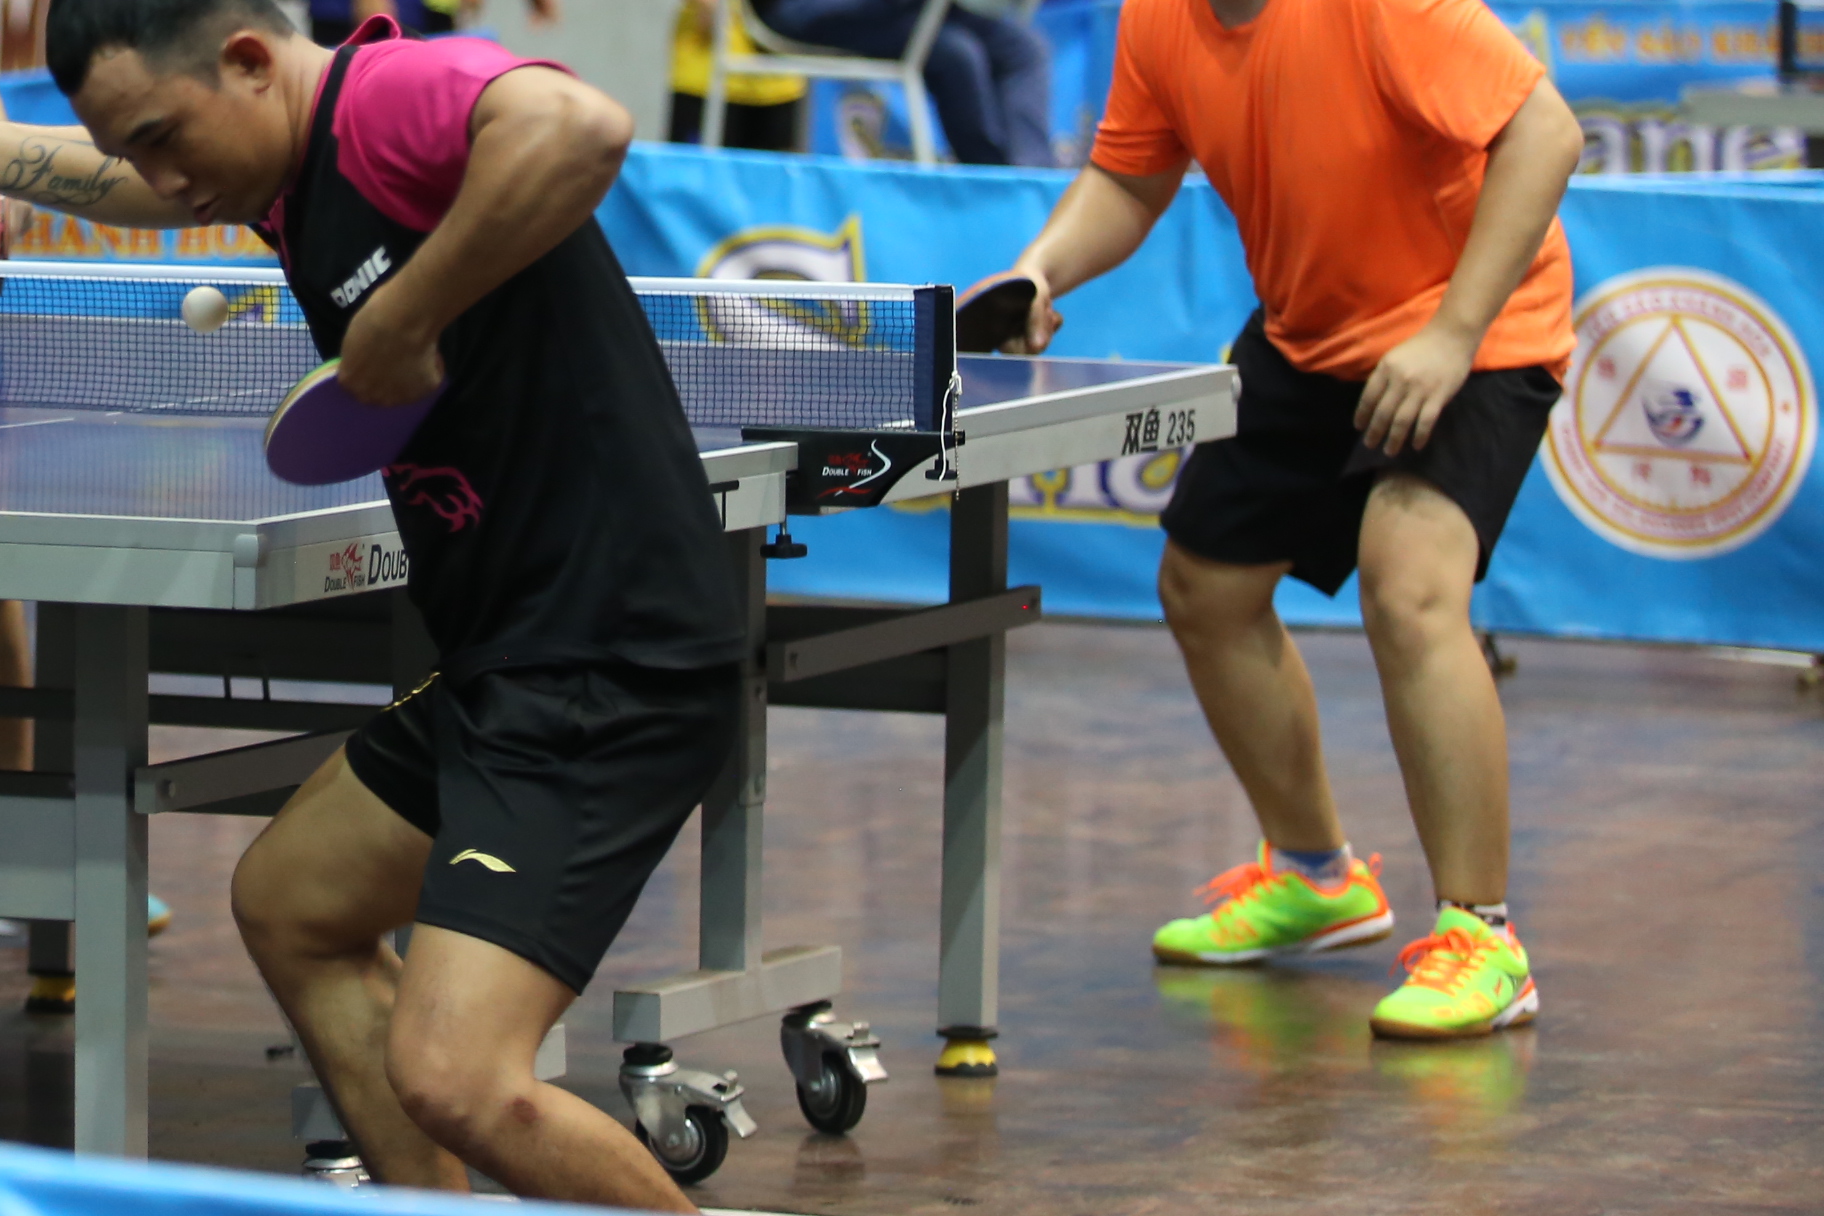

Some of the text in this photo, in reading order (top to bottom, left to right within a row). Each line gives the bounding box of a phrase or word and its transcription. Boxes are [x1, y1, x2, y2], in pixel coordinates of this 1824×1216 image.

[1, 136, 128, 205] Family
[330, 245, 392, 309] DONIC
[1166, 409, 1196, 445] 235
[822, 466, 872, 476] DOUBLE FISH
